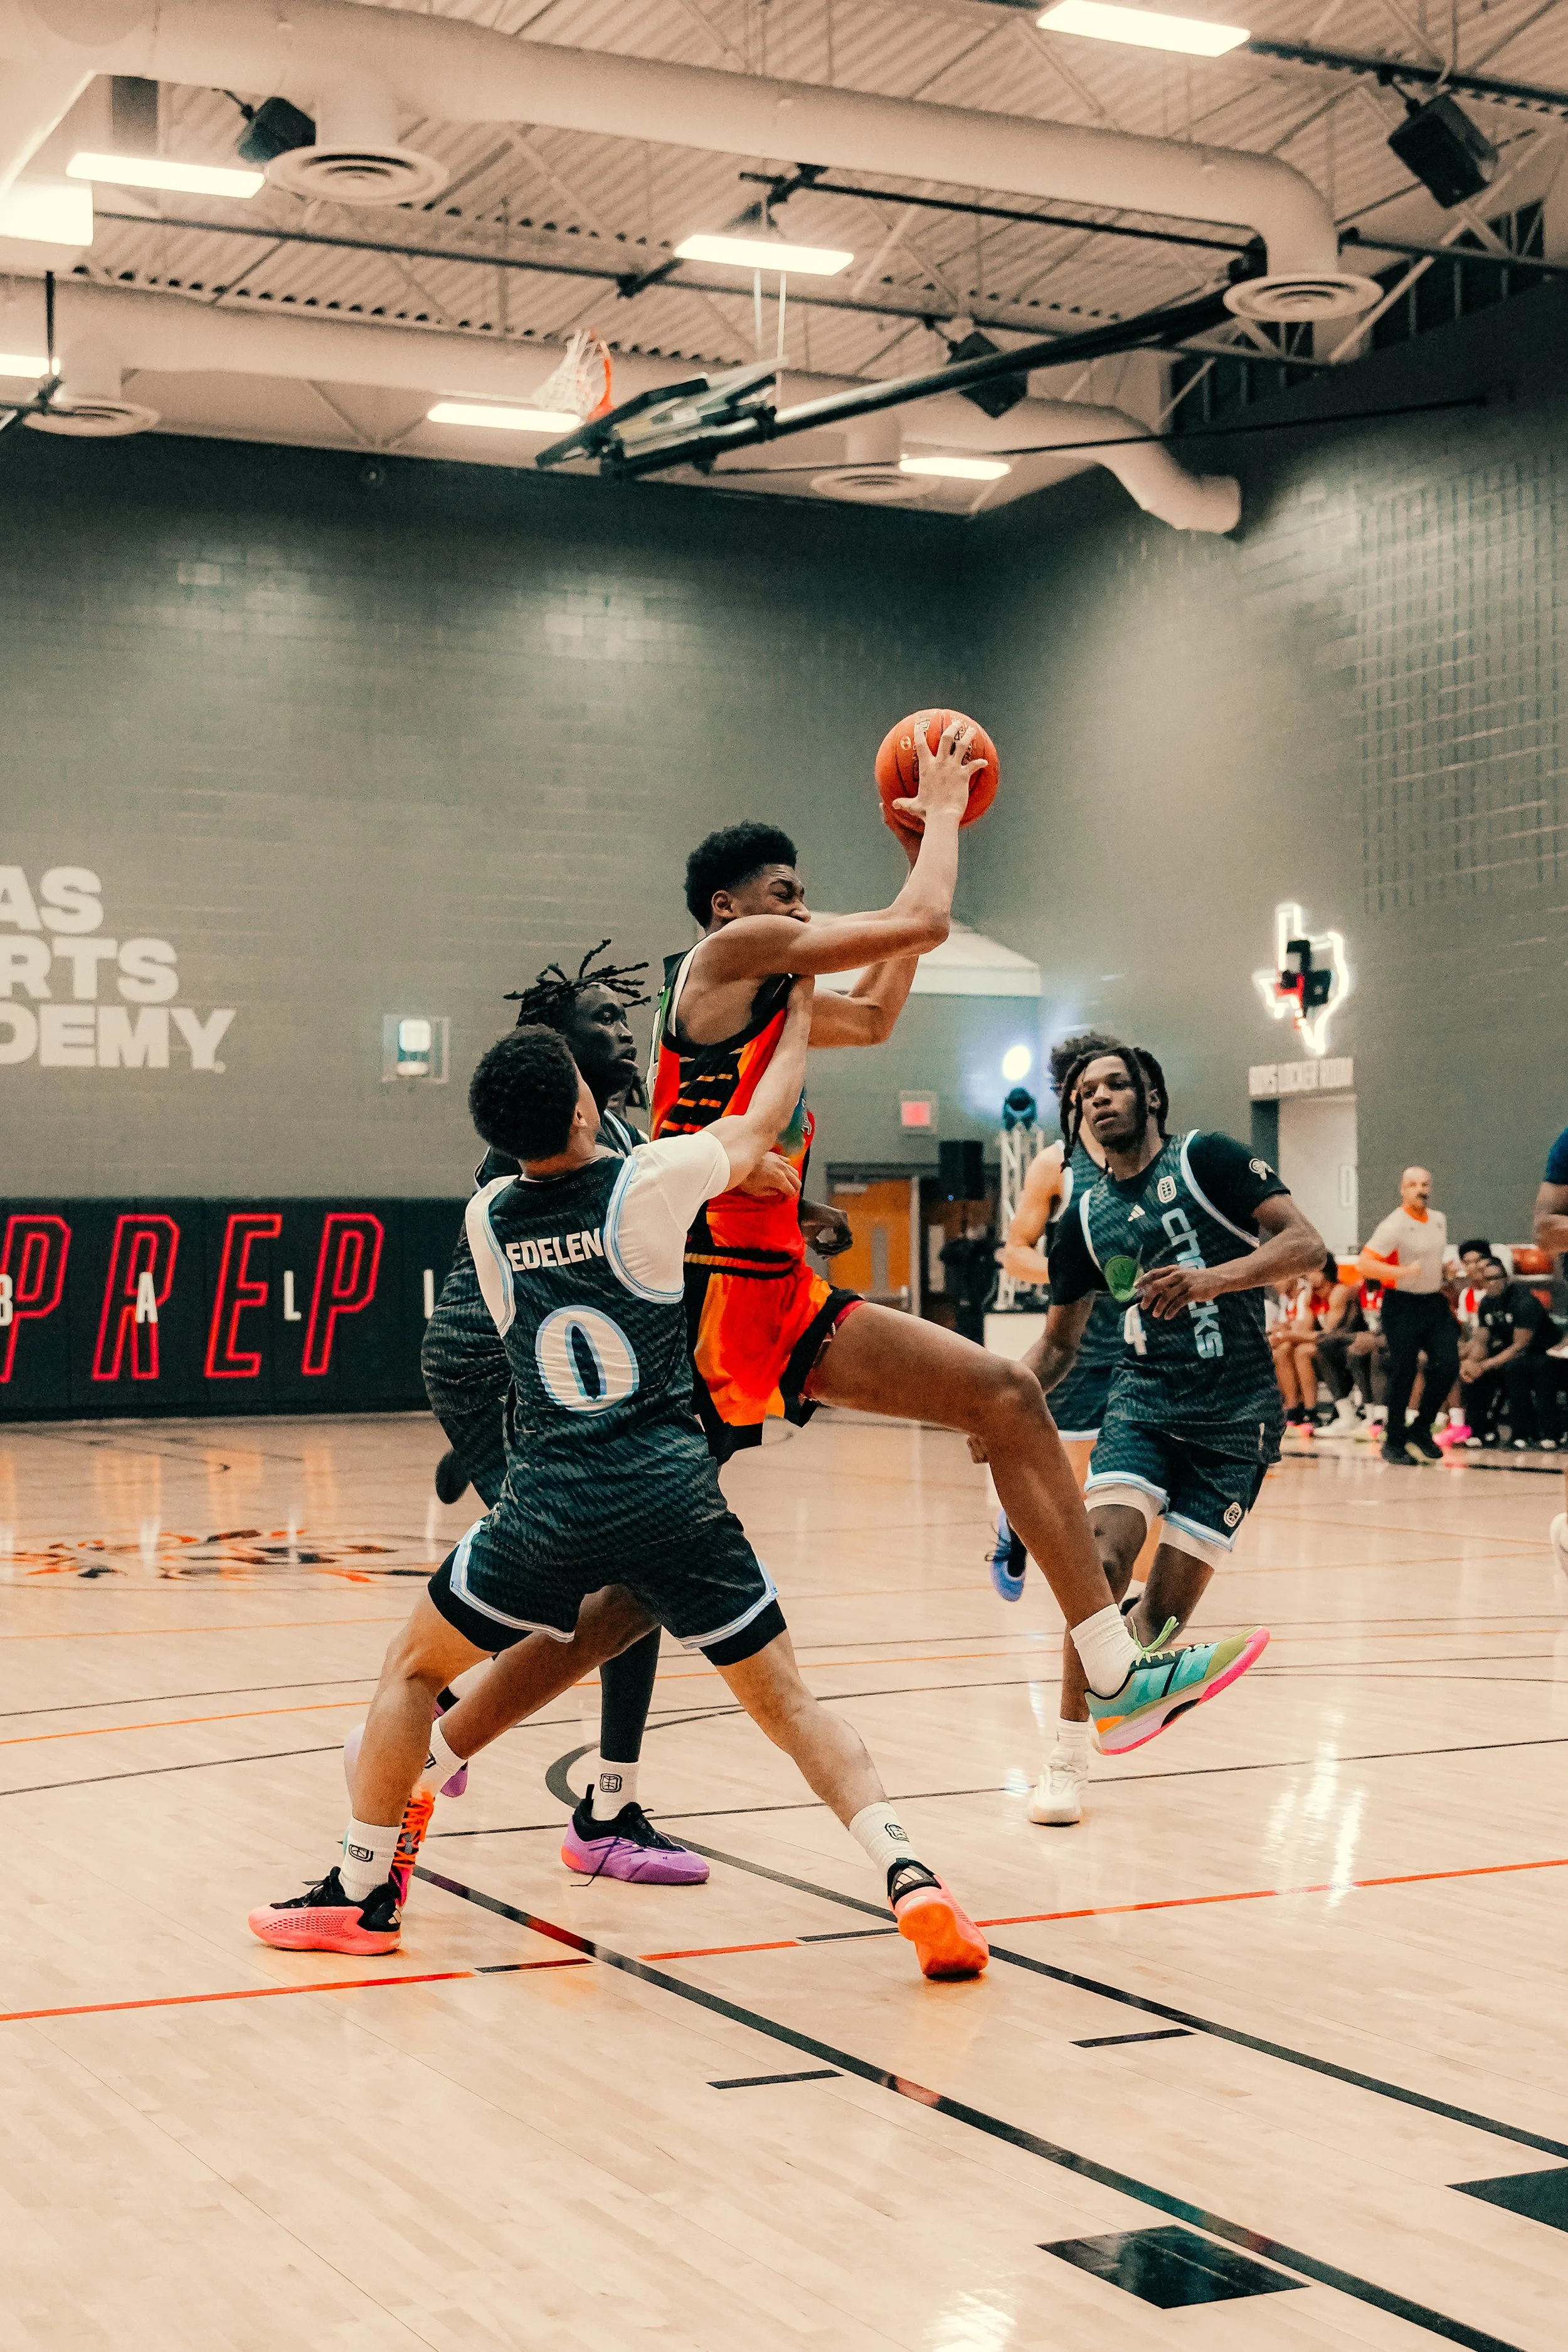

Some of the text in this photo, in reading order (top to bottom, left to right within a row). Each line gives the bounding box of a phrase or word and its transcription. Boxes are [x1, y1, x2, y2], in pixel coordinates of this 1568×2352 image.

[0, 1213, 384, 1382] PREP
[506, 1227, 604, 1272] EDELEN
[535, 1305, 640, 1417] 0
